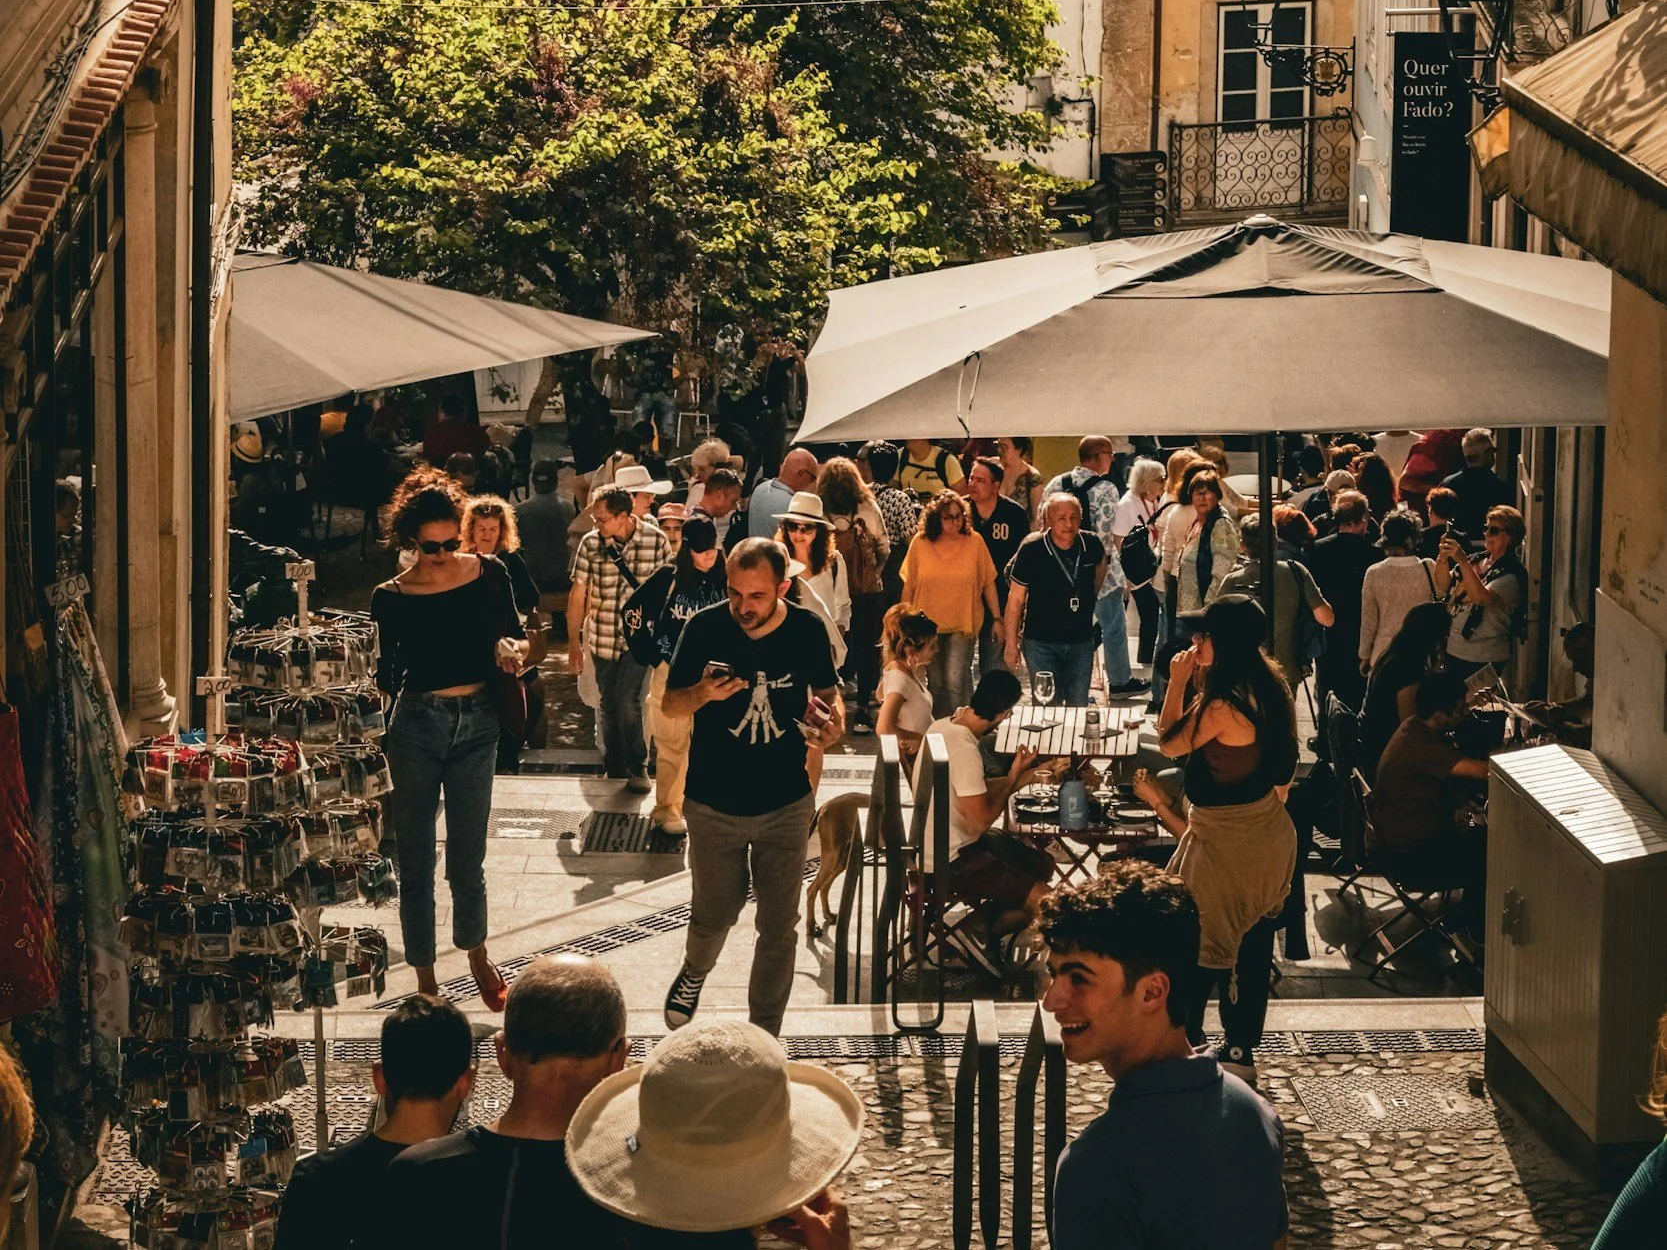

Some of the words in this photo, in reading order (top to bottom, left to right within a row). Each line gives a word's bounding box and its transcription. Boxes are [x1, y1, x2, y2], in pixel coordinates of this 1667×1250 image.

[1404, 59, 1449, 78] Quer
[1403, 82, 1447, 96] ouvir
[1403, 101, 1454, 117] Fado?
[992, 522, 1009, 540] 80
